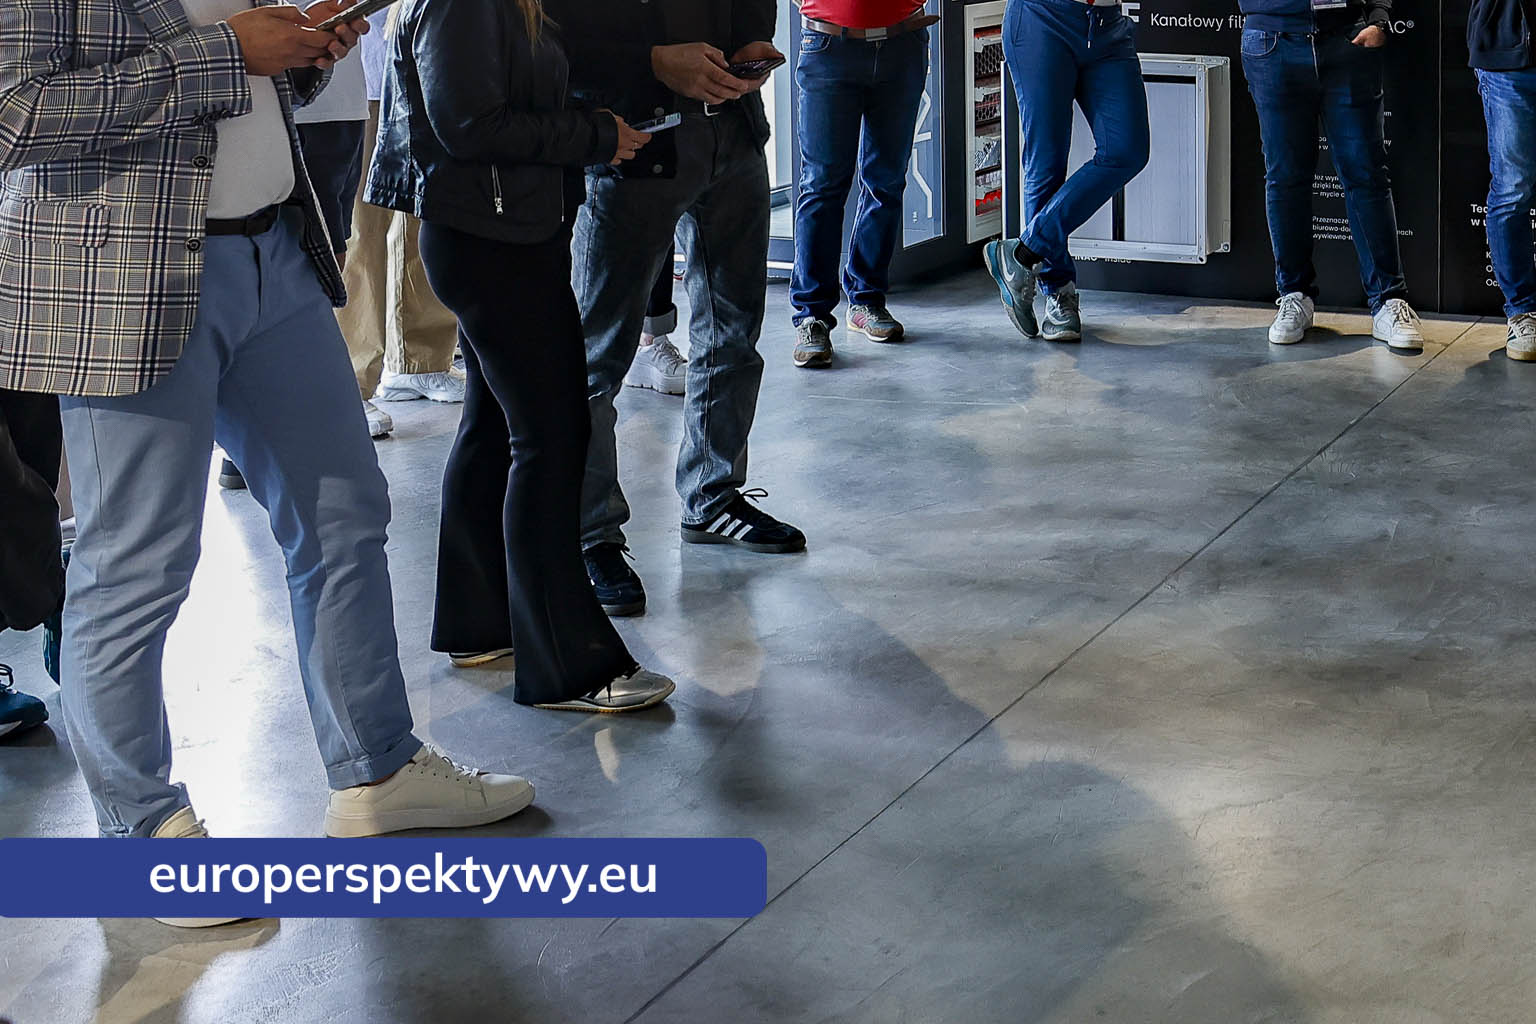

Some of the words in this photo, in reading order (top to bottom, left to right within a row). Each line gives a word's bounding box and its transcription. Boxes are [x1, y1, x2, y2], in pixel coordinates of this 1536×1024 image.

[1151, 13, 1224, 32] Kanałowy
[1228, 15, 1246, 29] filt
[1312, 215, 1349, 225] Przeznacze
[1312, 224, 1351, 233] biurowo-do
